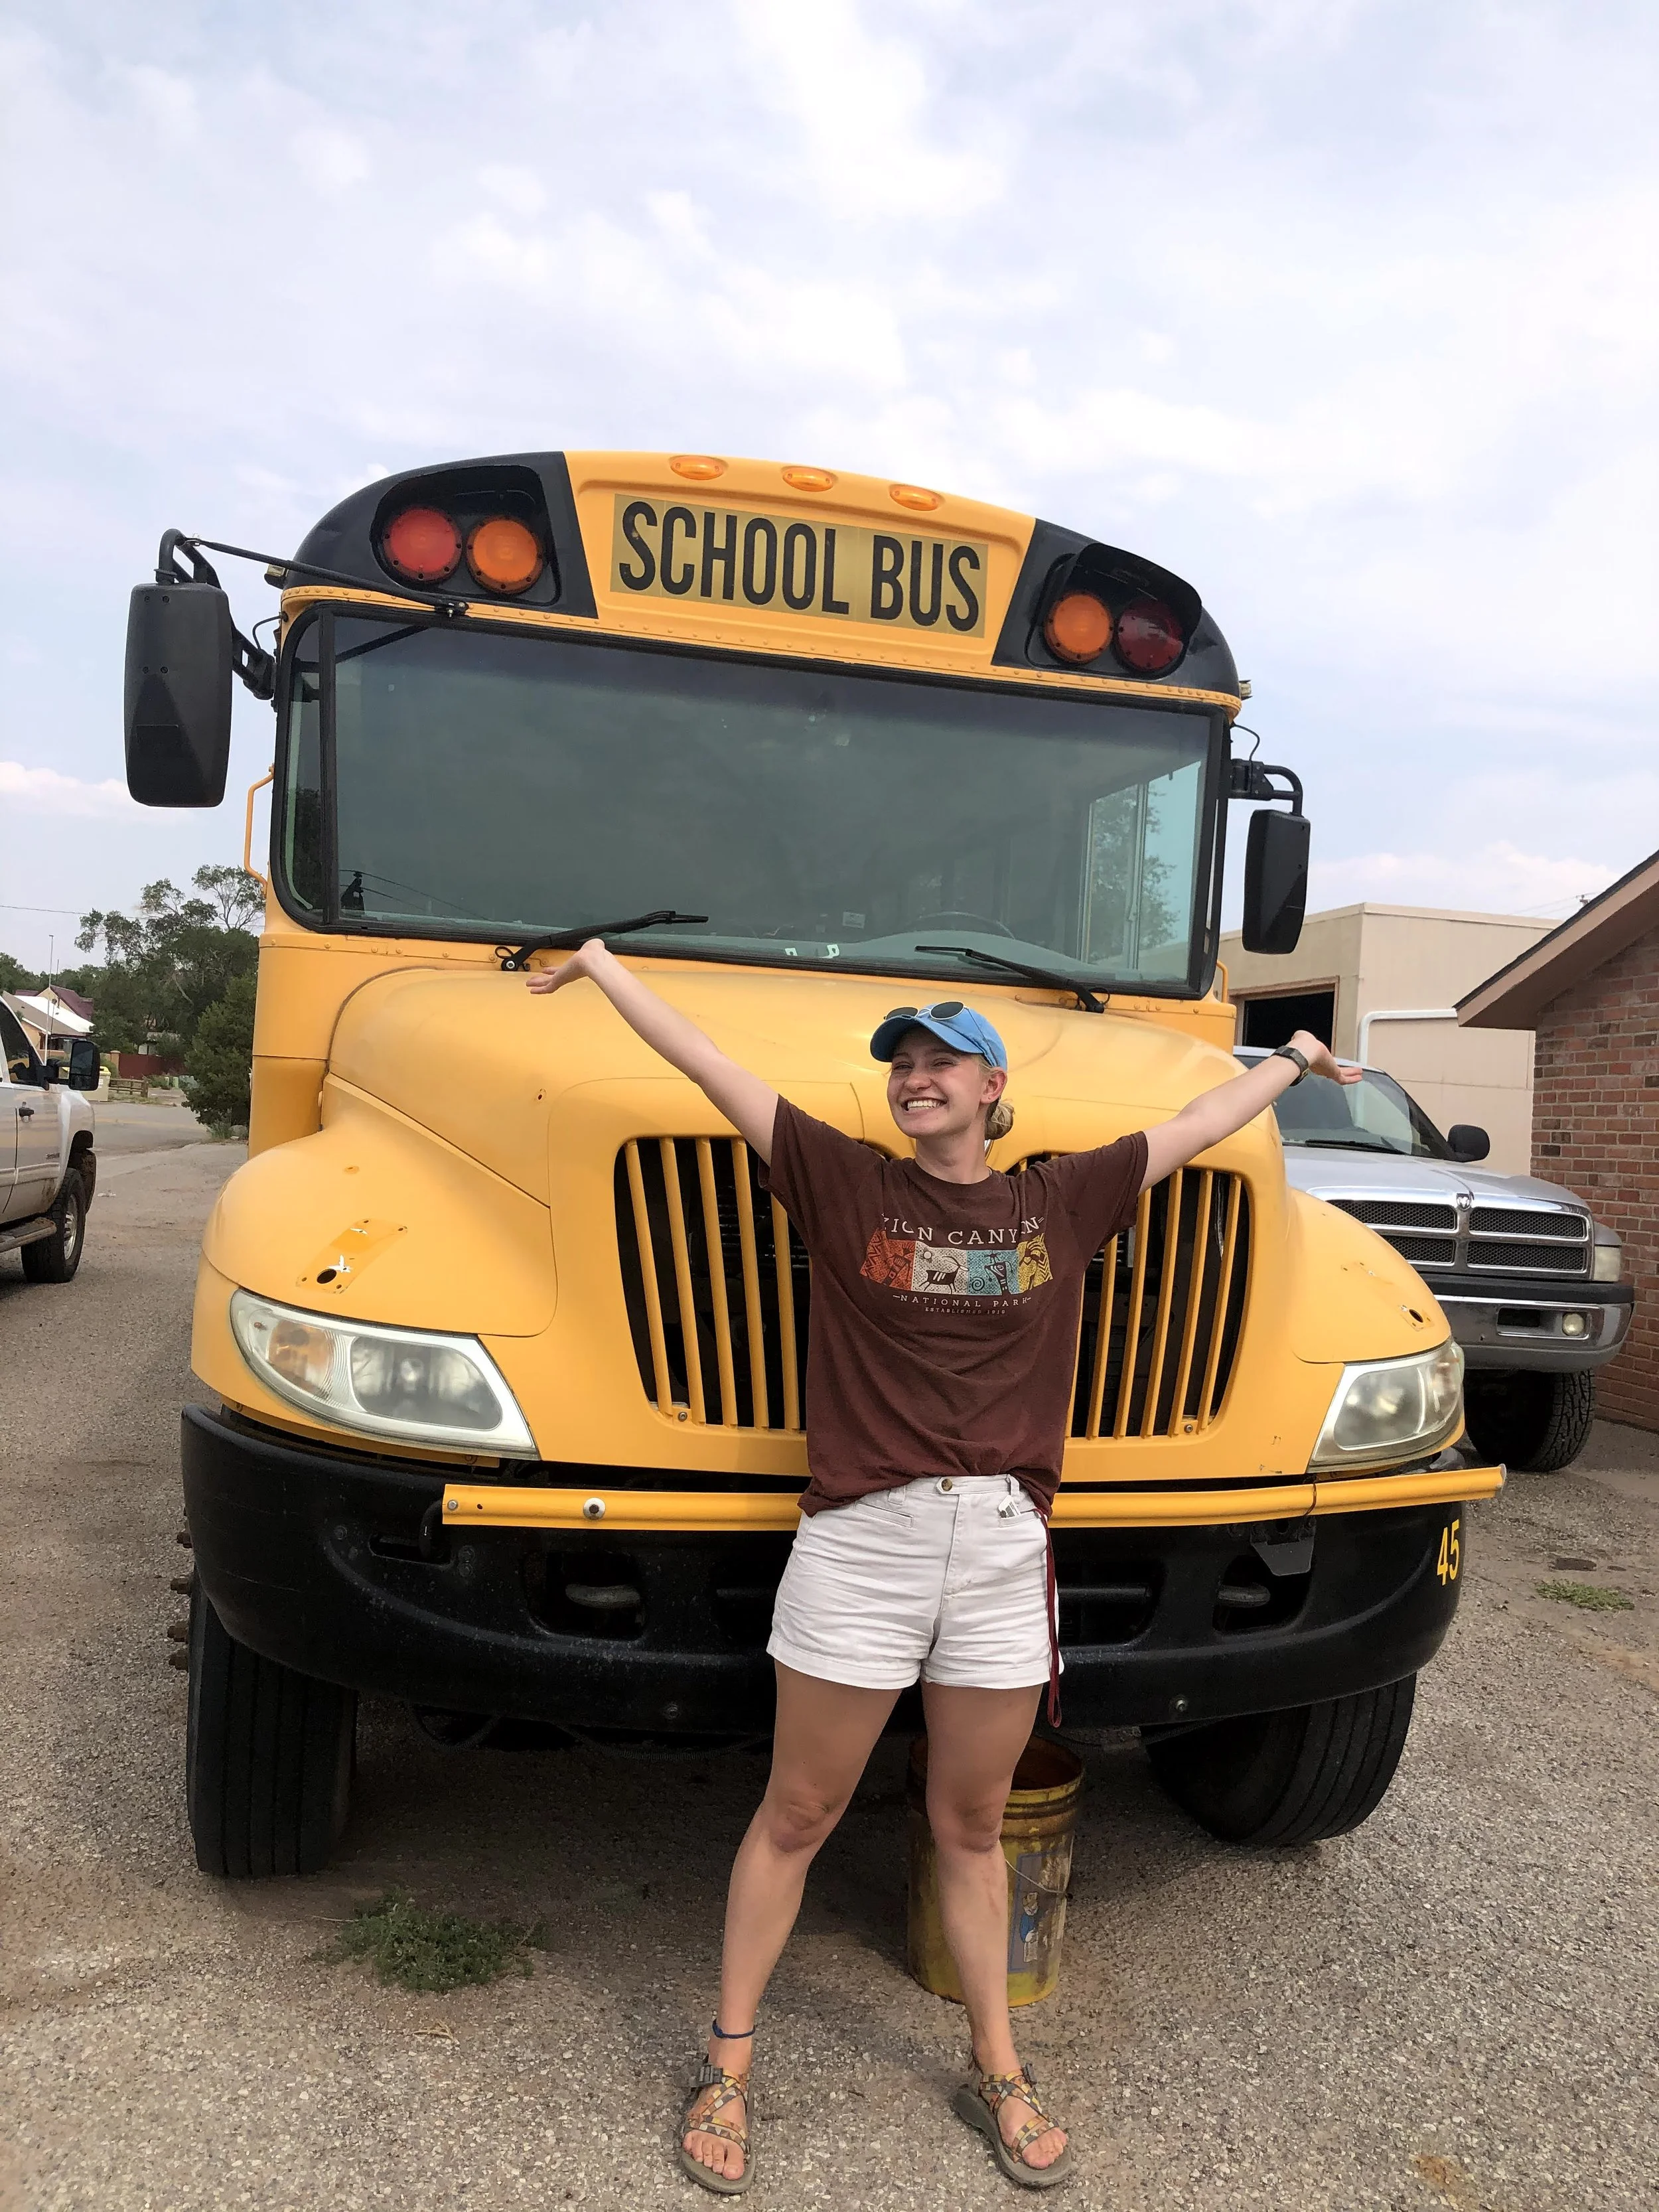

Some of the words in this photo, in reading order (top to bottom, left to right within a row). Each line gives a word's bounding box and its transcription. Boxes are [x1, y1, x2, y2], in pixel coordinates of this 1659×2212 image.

[618, 500, 850, 615] SCHOOL
[870, 534, 981, 632] BUS
[901, 1294, 981, 1307] NATIONAL
[993, 1297, 1027, 1307] PARK
[1437, 1518, 1459, 1586] 45
